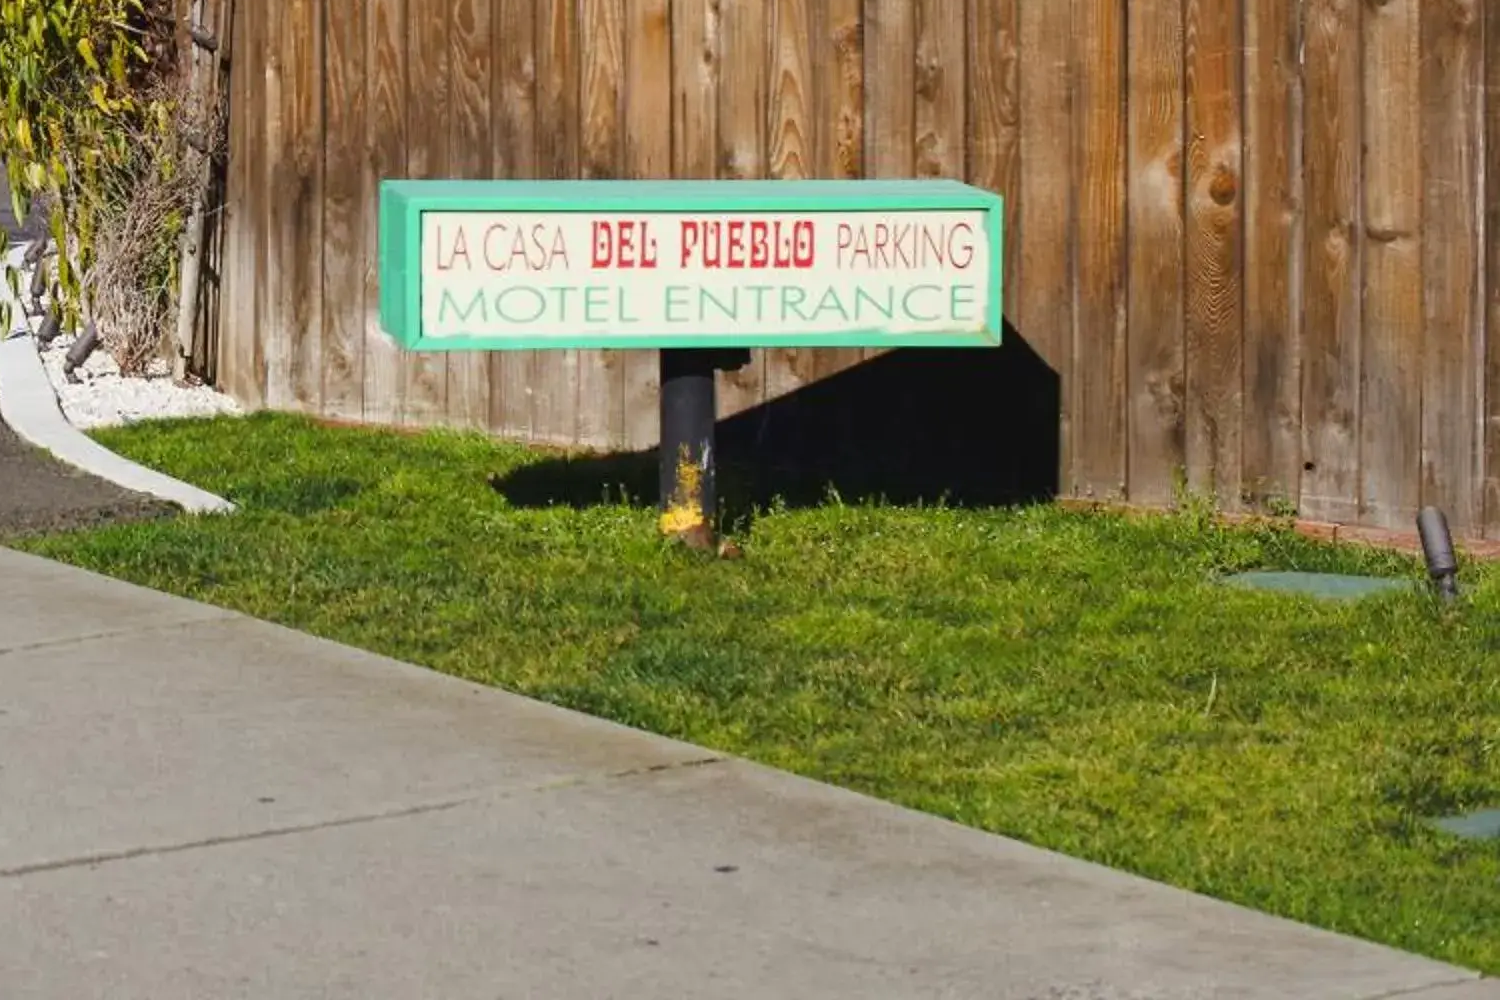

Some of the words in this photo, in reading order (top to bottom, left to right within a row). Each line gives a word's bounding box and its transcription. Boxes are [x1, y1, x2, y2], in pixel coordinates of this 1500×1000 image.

[437, 223, 472, 272] LA
[483, 222, 569, 272] CASA
[590, 219, 658, 270] DEL
[679, 219, 816, 270] PUEBLO
[835, 222, 975, 270] PARKING
[437, 285, 641, 324] MOTEL
[664, 284, 976, 323] ENTRANCE
